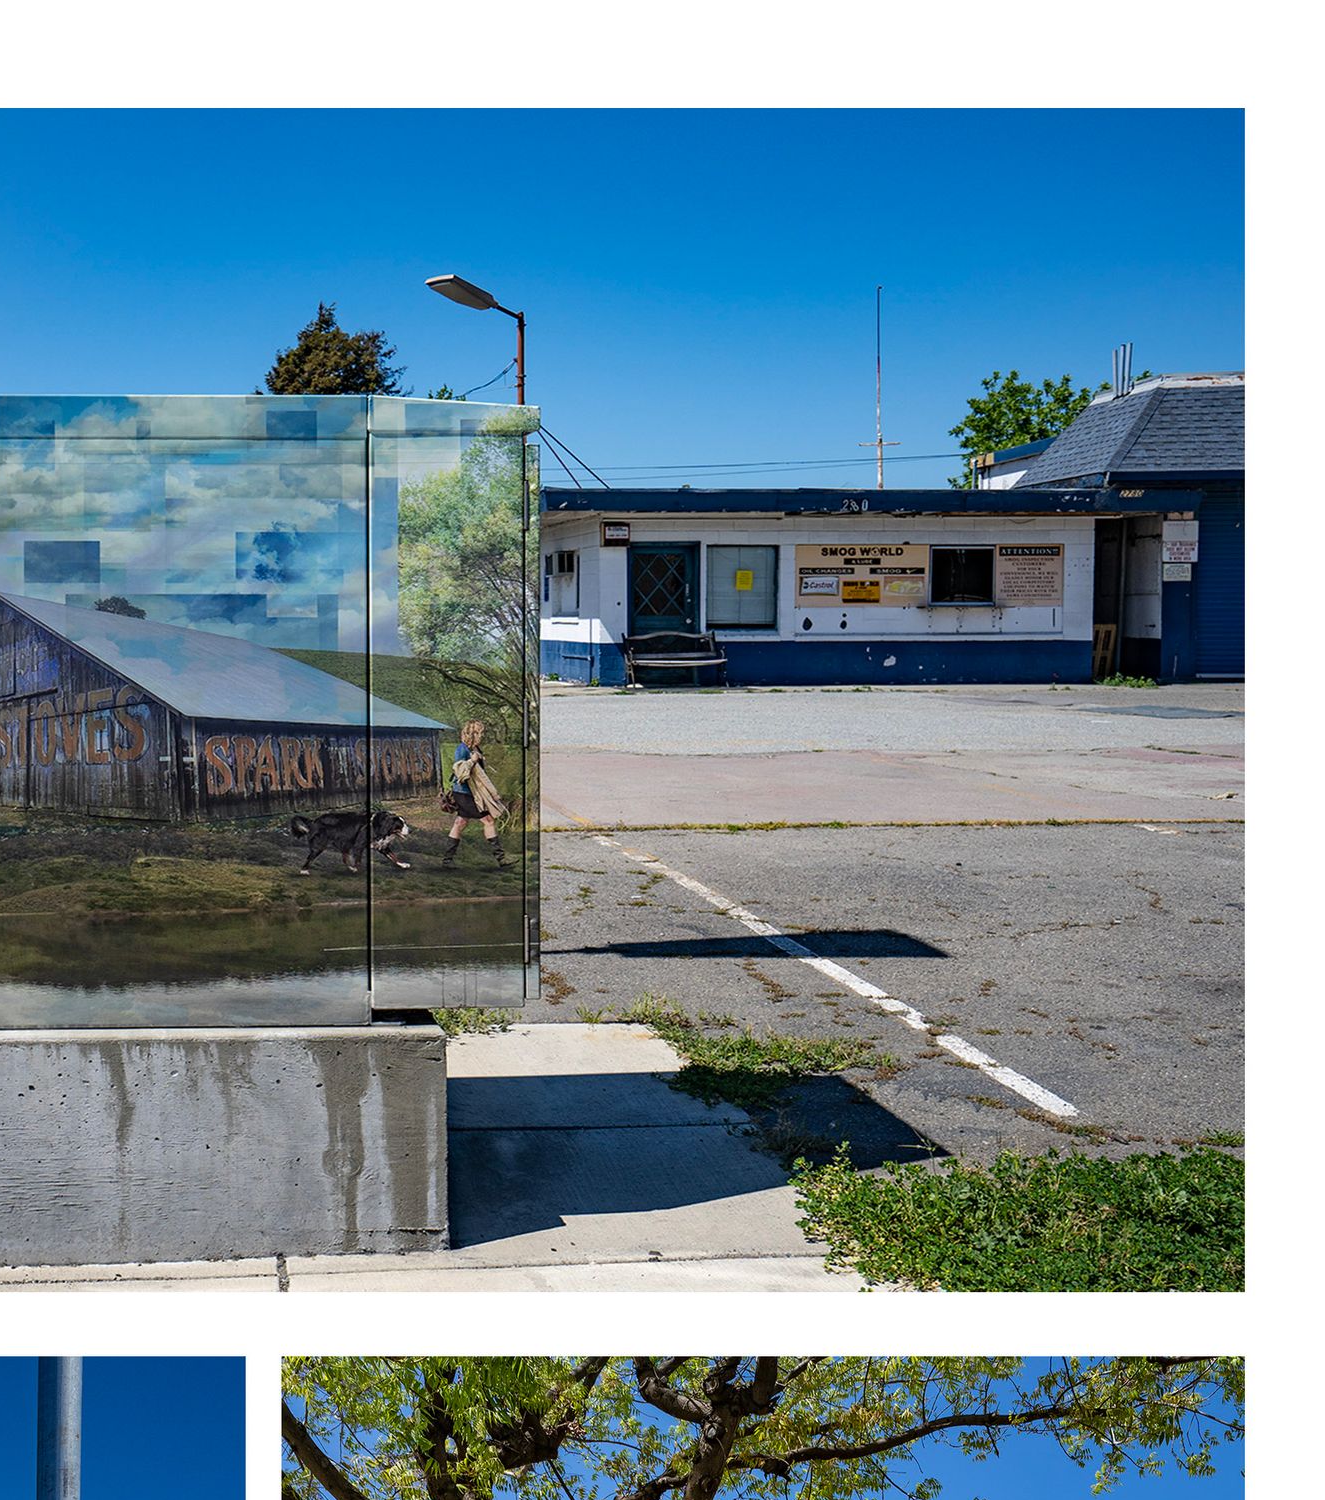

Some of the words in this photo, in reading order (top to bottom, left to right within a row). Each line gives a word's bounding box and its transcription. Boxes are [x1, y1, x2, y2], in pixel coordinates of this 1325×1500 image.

[821, 547, 856, 556] SMOG
[859, 547, 904, 556] WORLD
[205, 735, 325, 796] SPARK
